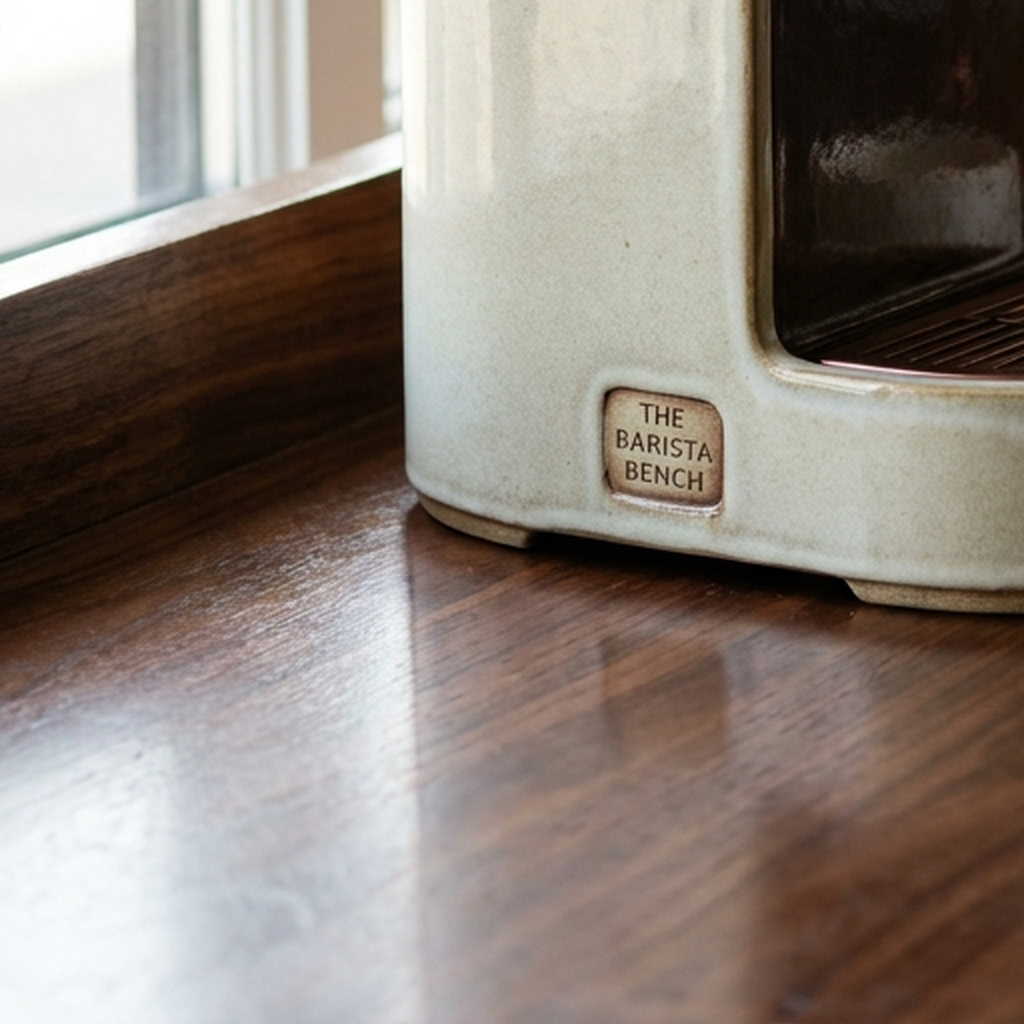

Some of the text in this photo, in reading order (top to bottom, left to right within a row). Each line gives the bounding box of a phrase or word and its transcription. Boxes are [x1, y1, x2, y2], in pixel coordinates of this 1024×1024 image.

[639, 402, 684, 428] THE
[616, 429, 713, 463] BARISTA
[625, 460, 703, 492] BENCH
